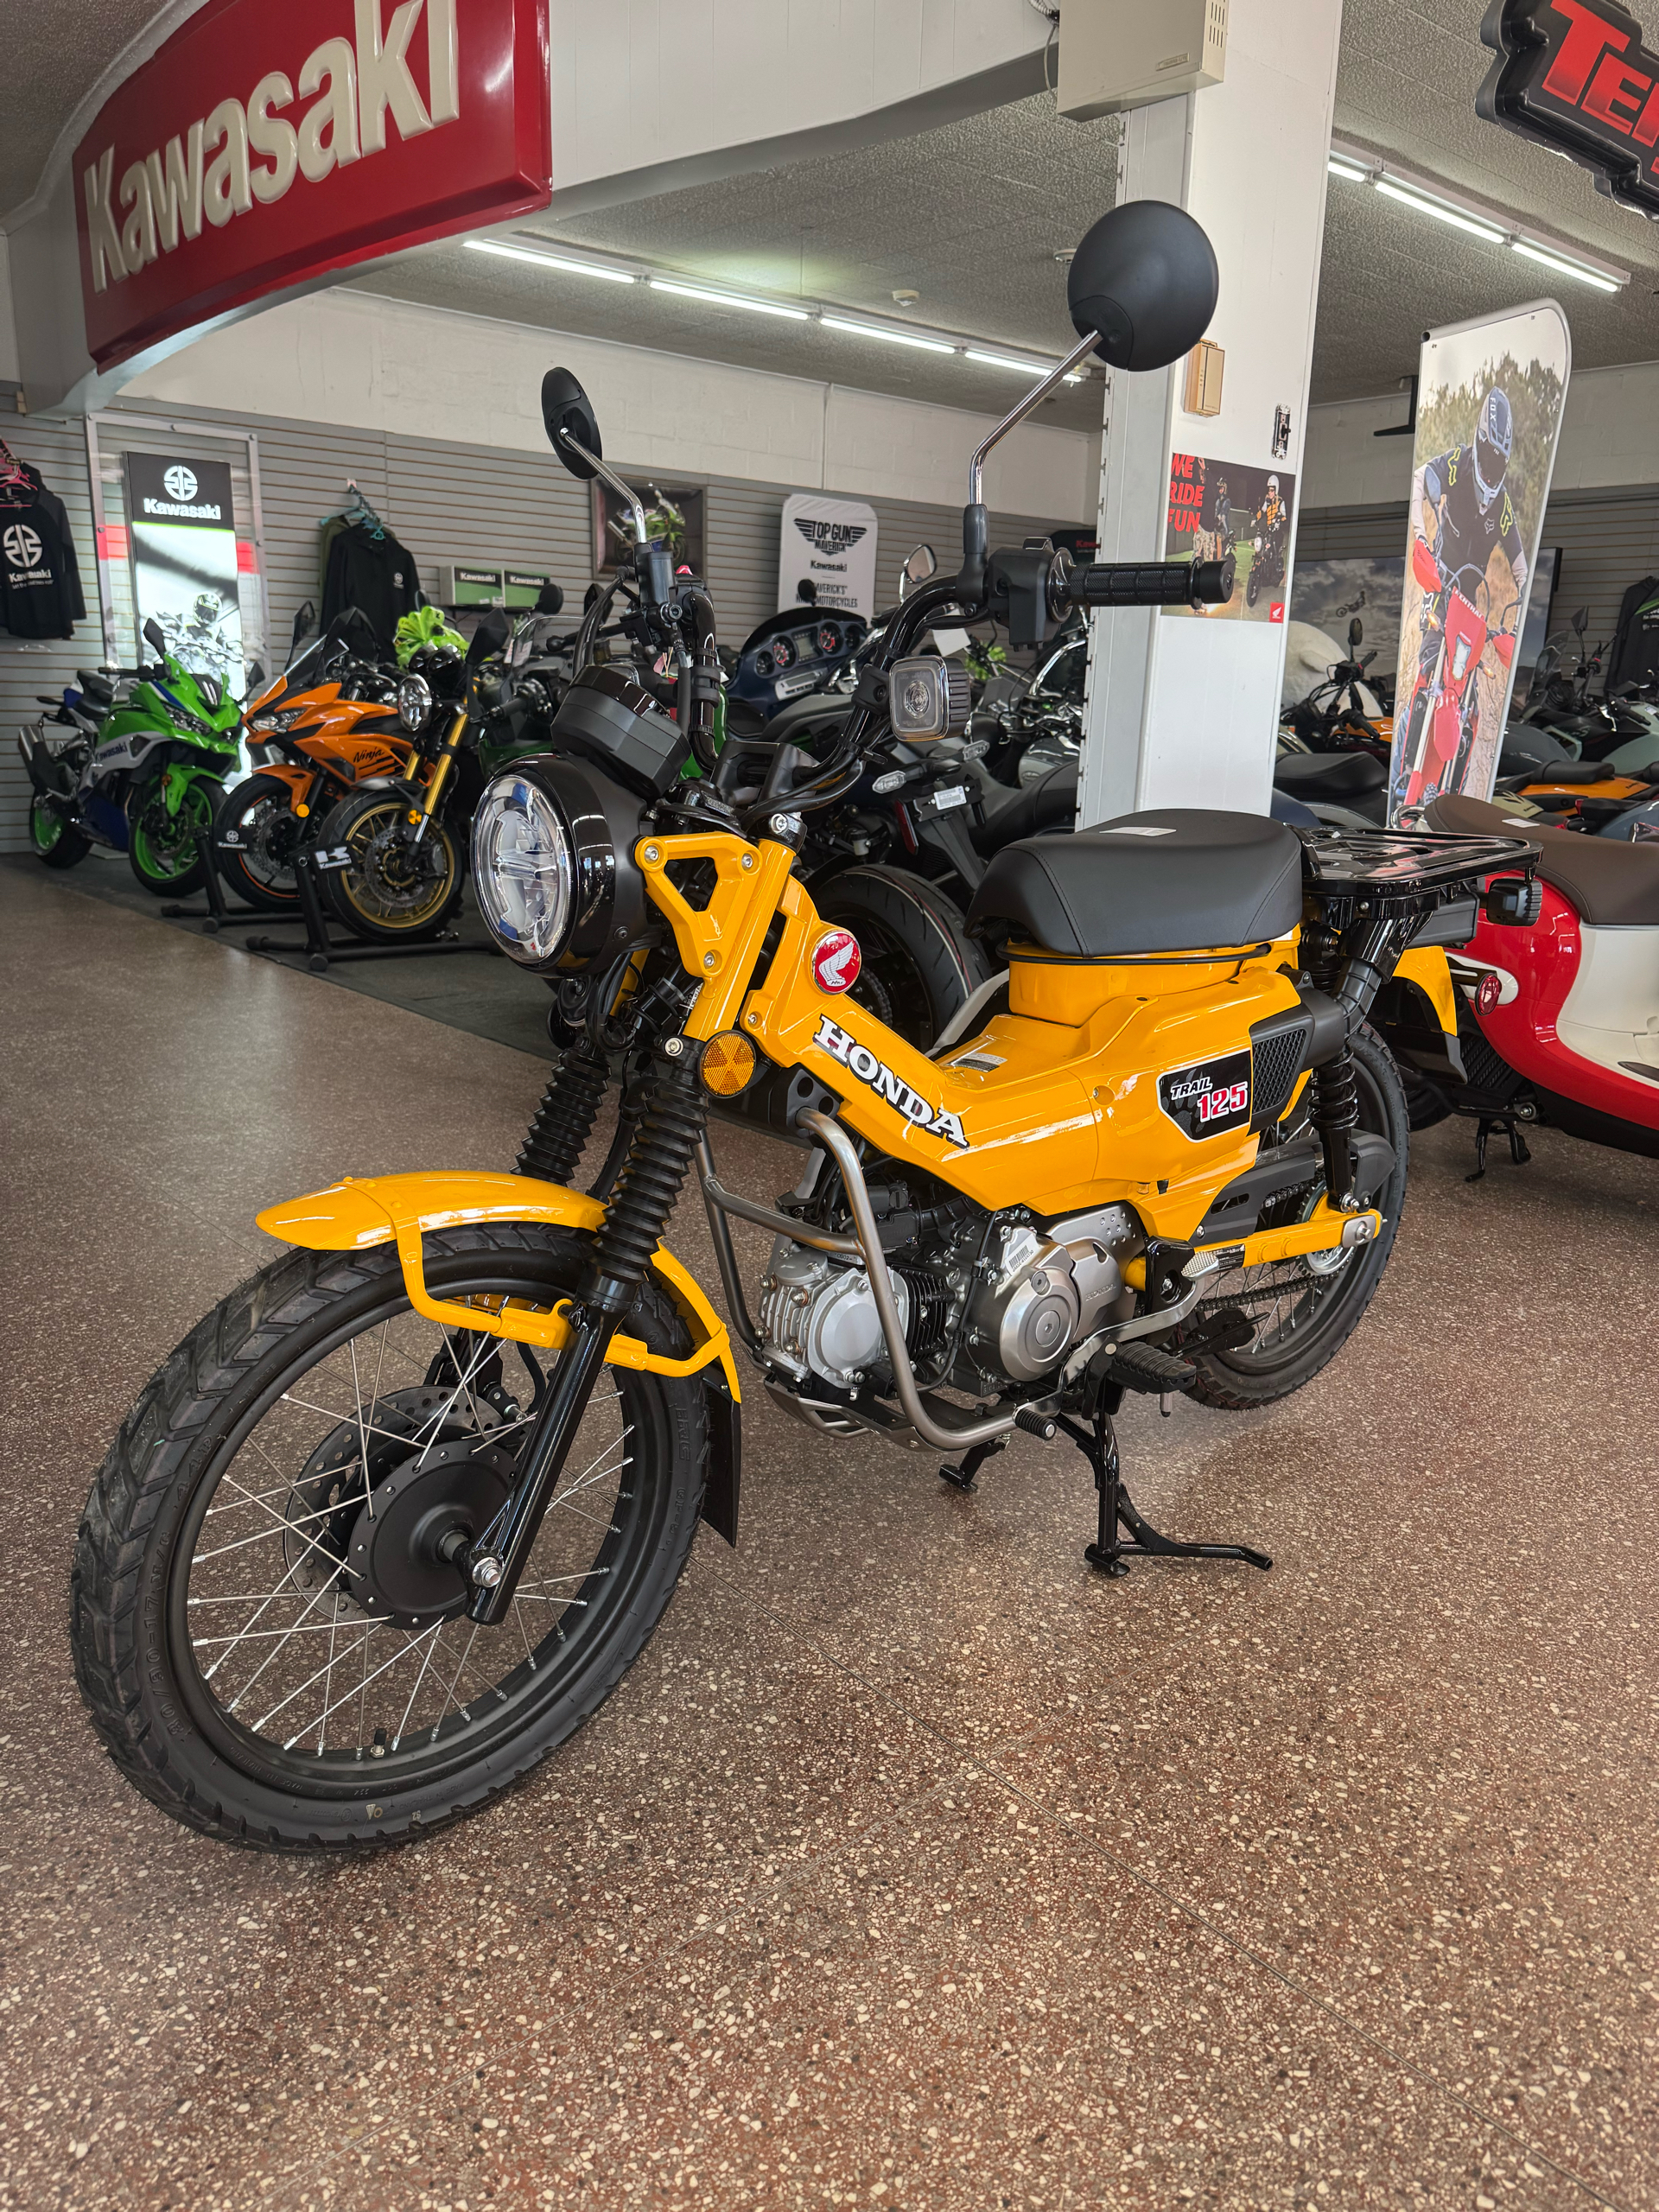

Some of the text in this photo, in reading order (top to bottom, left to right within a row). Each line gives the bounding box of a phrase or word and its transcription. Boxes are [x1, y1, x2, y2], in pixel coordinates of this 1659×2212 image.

[84, 0, 459, 295] Kawasaki
[1170, 481, 1205, 507] RIDE
[143, 497, 221, 520] Kawasaki
[811, 521, 852, 543] TOP GUN
[814, 539, 847, 553] MAVERICK
[460, 571, 496, 582] Kawasaki
[810, 559, 848, 572] Kawasaki
[510, 575, 544, 586] Kawasaki
[353, 747, 385, 764] Ninja
[812, 1014, 969, 1150] HONDA
[1170, 1077, 1213, 1100] TRAIL
[1197, 1081, 1248, 1122] 125
